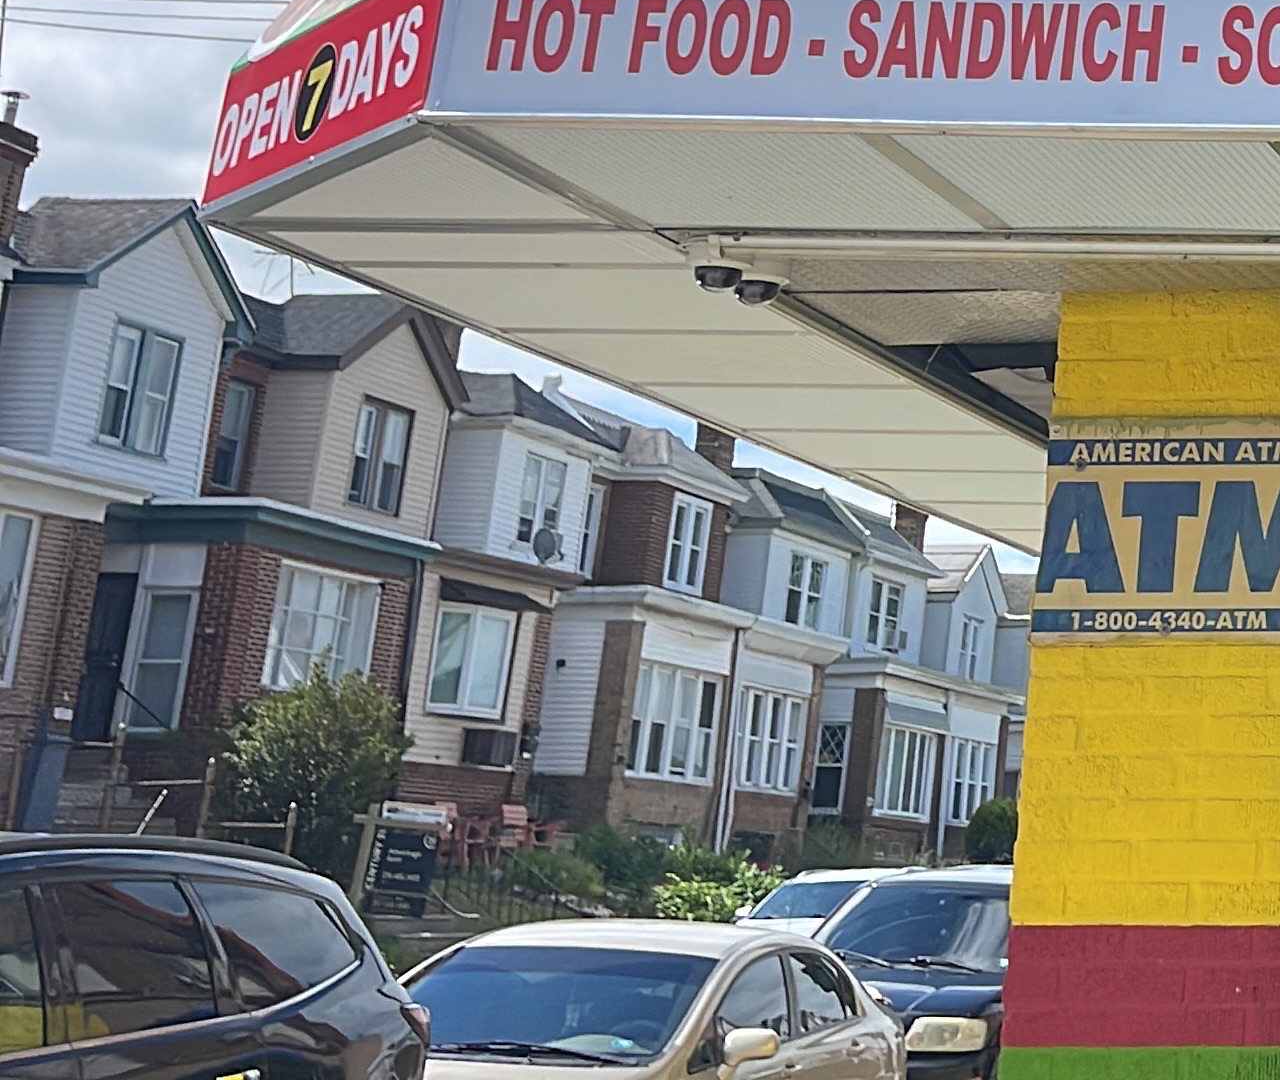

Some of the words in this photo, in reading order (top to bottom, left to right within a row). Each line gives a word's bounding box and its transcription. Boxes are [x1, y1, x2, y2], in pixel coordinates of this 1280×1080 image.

[212, 69, 303, 177] OPEN
[301, 59, 334, 133] 7
[328, 4, 424, 120] DAYS
[1069, 441, 1224, 463] AMERICAN
[1071, 611, 1267, 631] 1-800-4340-ATM
